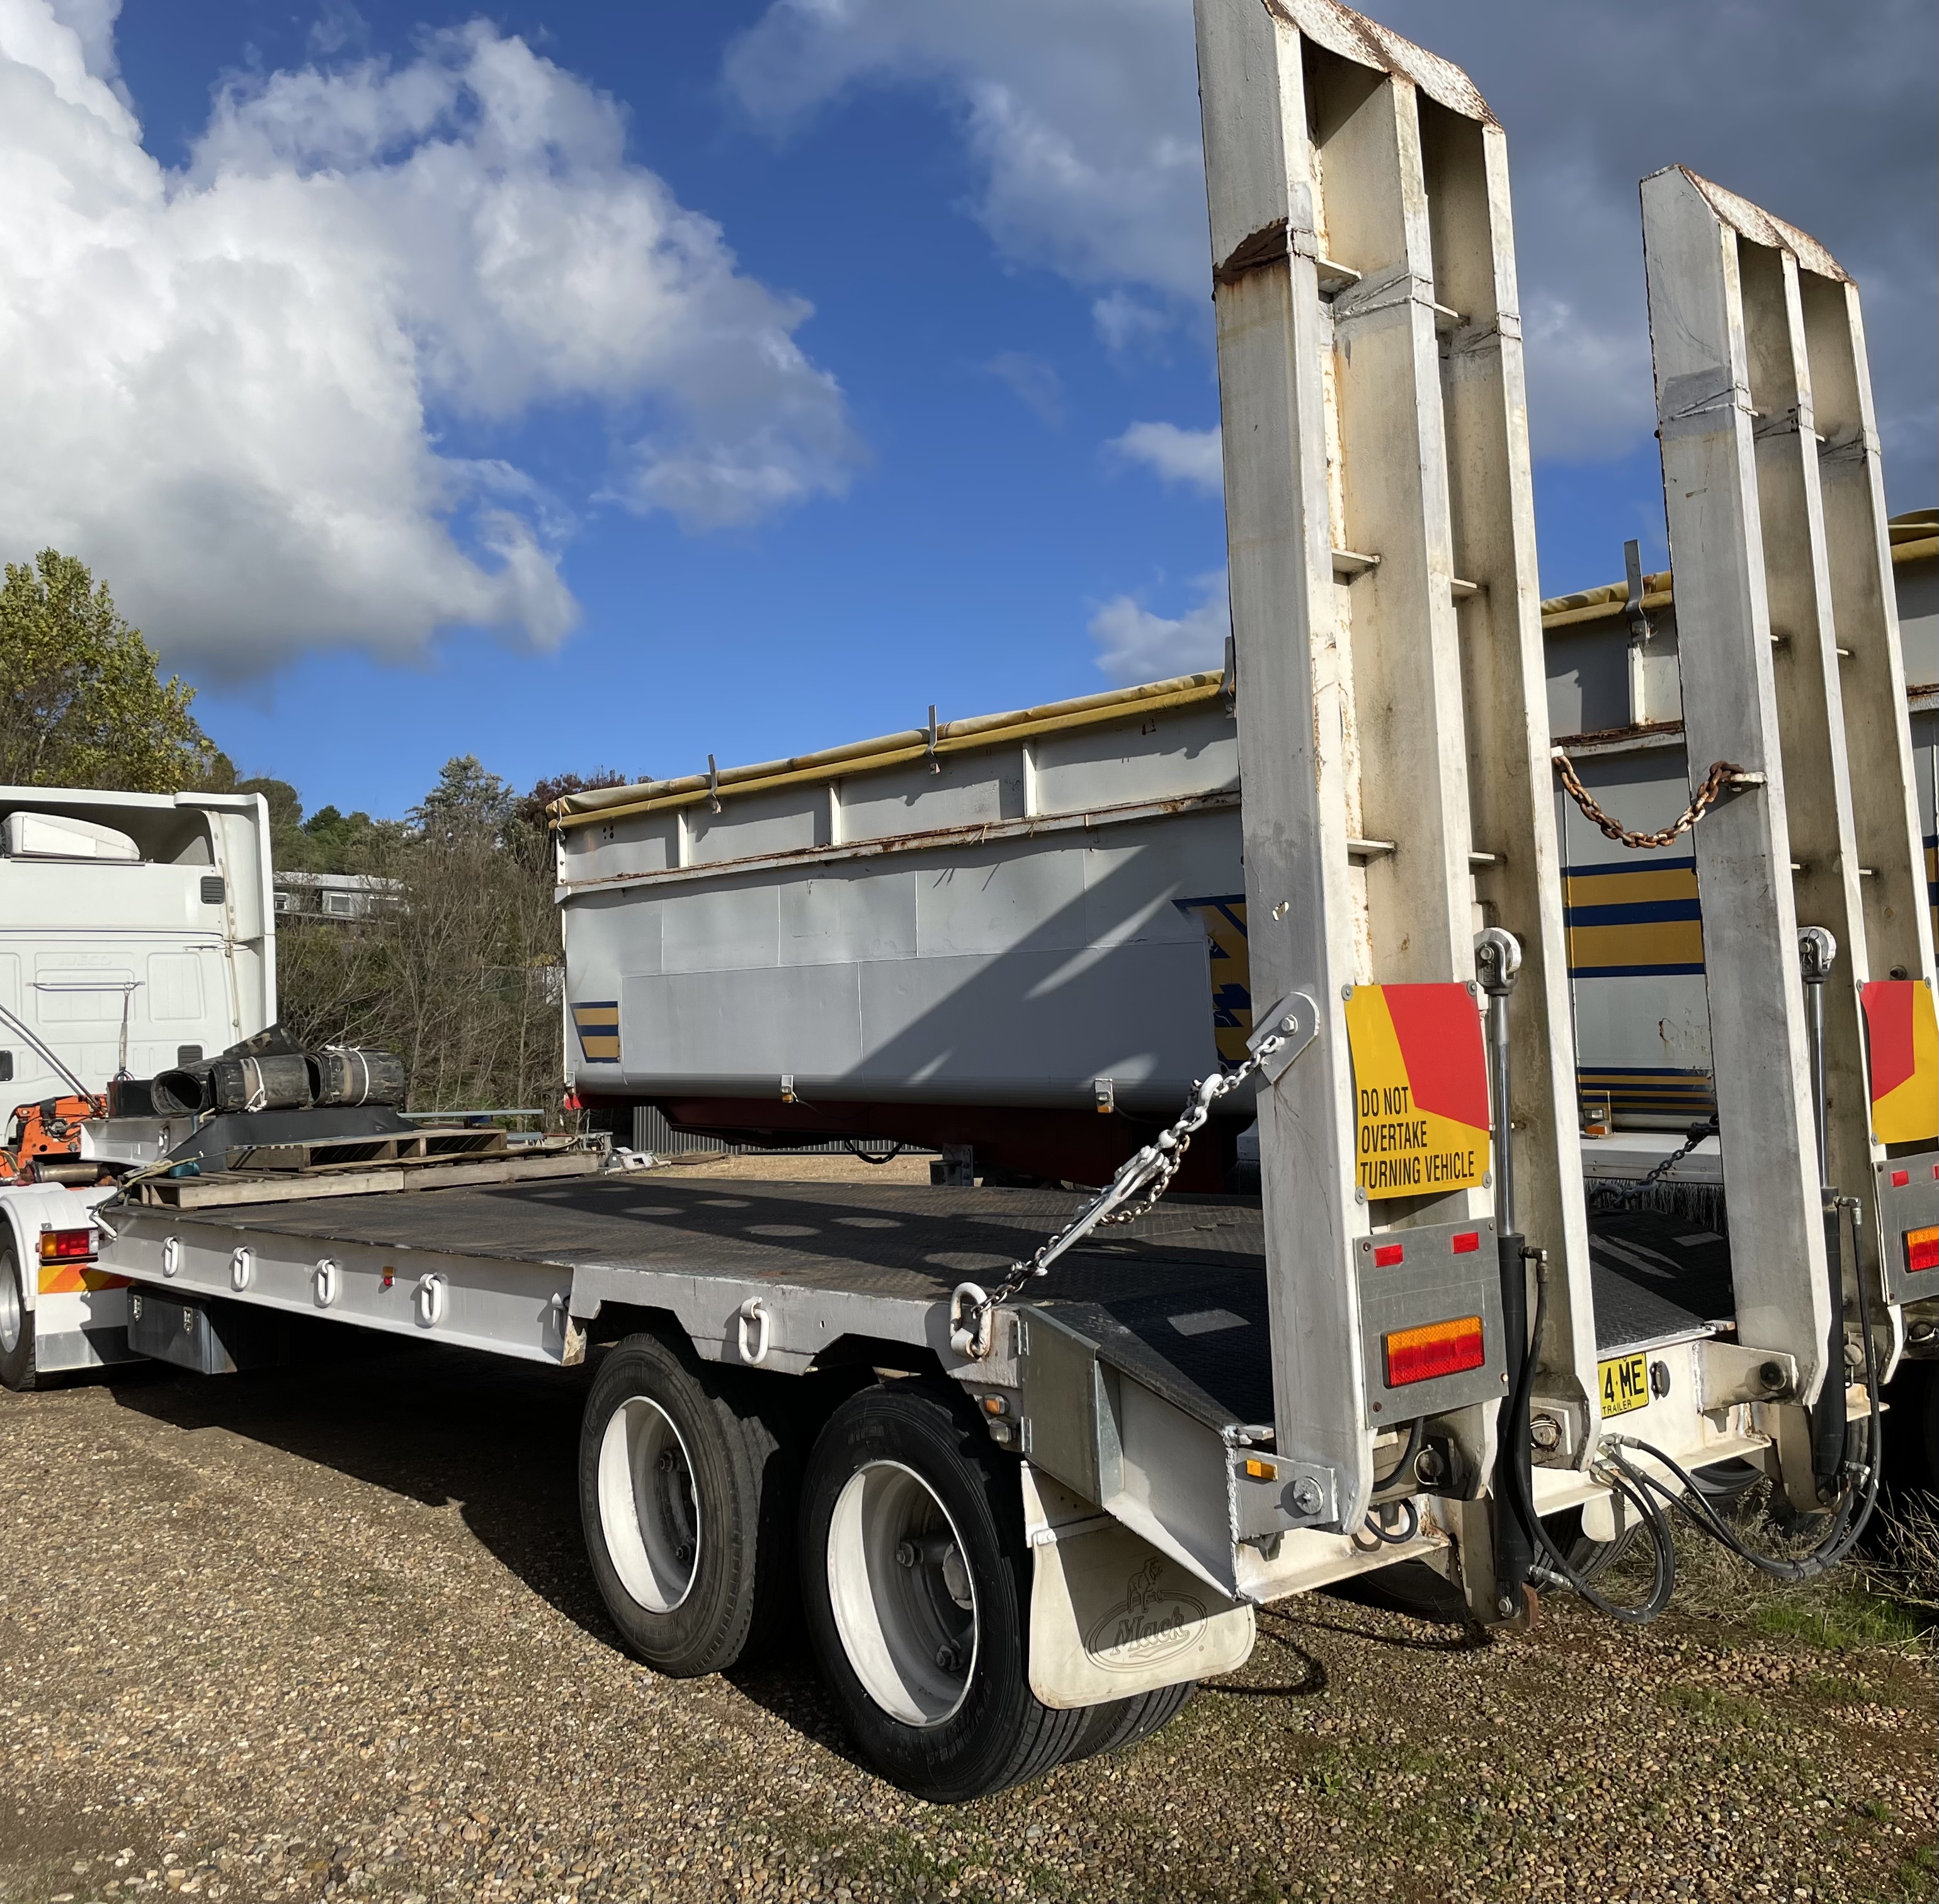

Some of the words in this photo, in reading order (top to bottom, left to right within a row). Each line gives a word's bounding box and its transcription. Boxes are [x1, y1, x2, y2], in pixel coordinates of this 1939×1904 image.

[1361, 1089, 1379, 1117] DO
[1383, 1086, 1408, 1115] NOT
[1361, 1120, 1428, 1153] OVERTAKE
[1360, 1156, 1421, 1189] TURNING
[1424, 1150, 1474, 1182] VEHICLE
[1602, 1399, 1632, 1415] TRAILER
[1110, 1606, 1190, 1656] Mack
